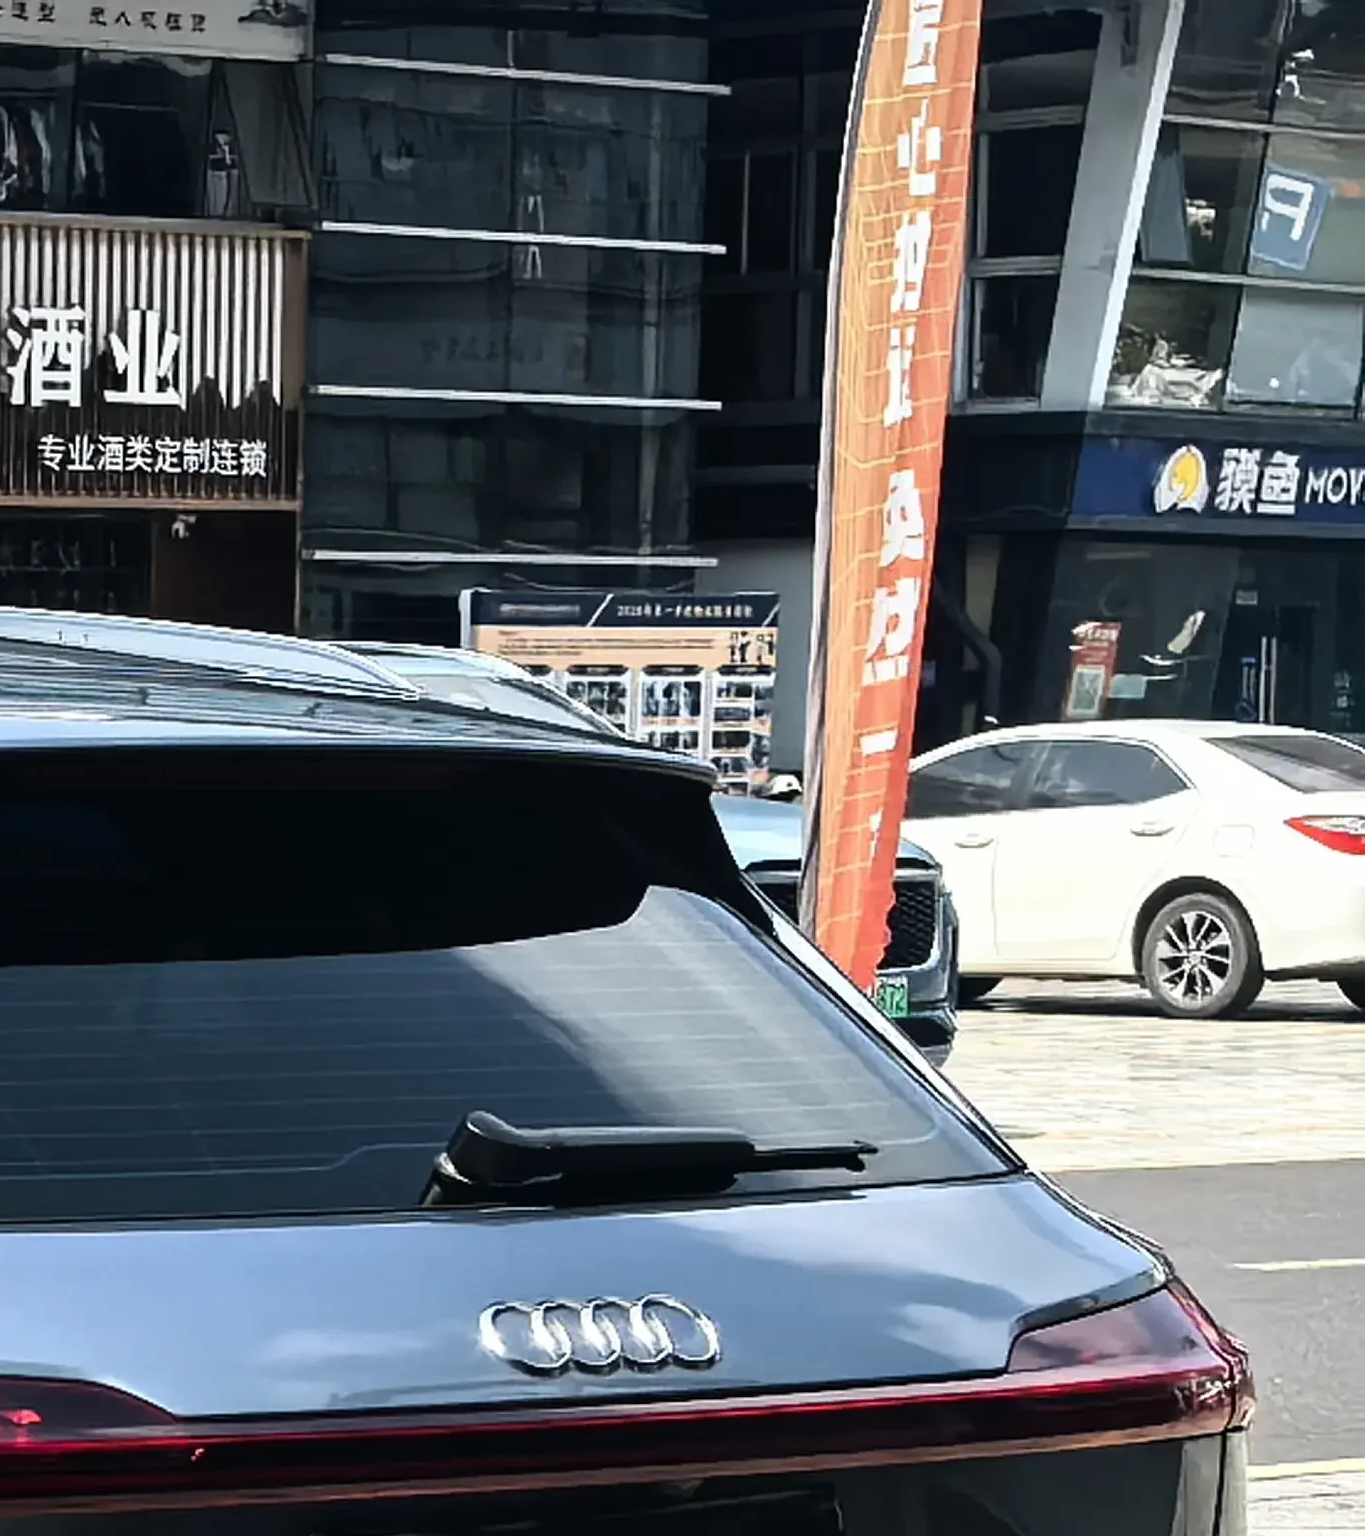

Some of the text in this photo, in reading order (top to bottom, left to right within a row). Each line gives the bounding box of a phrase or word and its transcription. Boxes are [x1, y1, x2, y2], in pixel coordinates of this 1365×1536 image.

[37, 434, 267, 477] 专业酒类定制连锁
